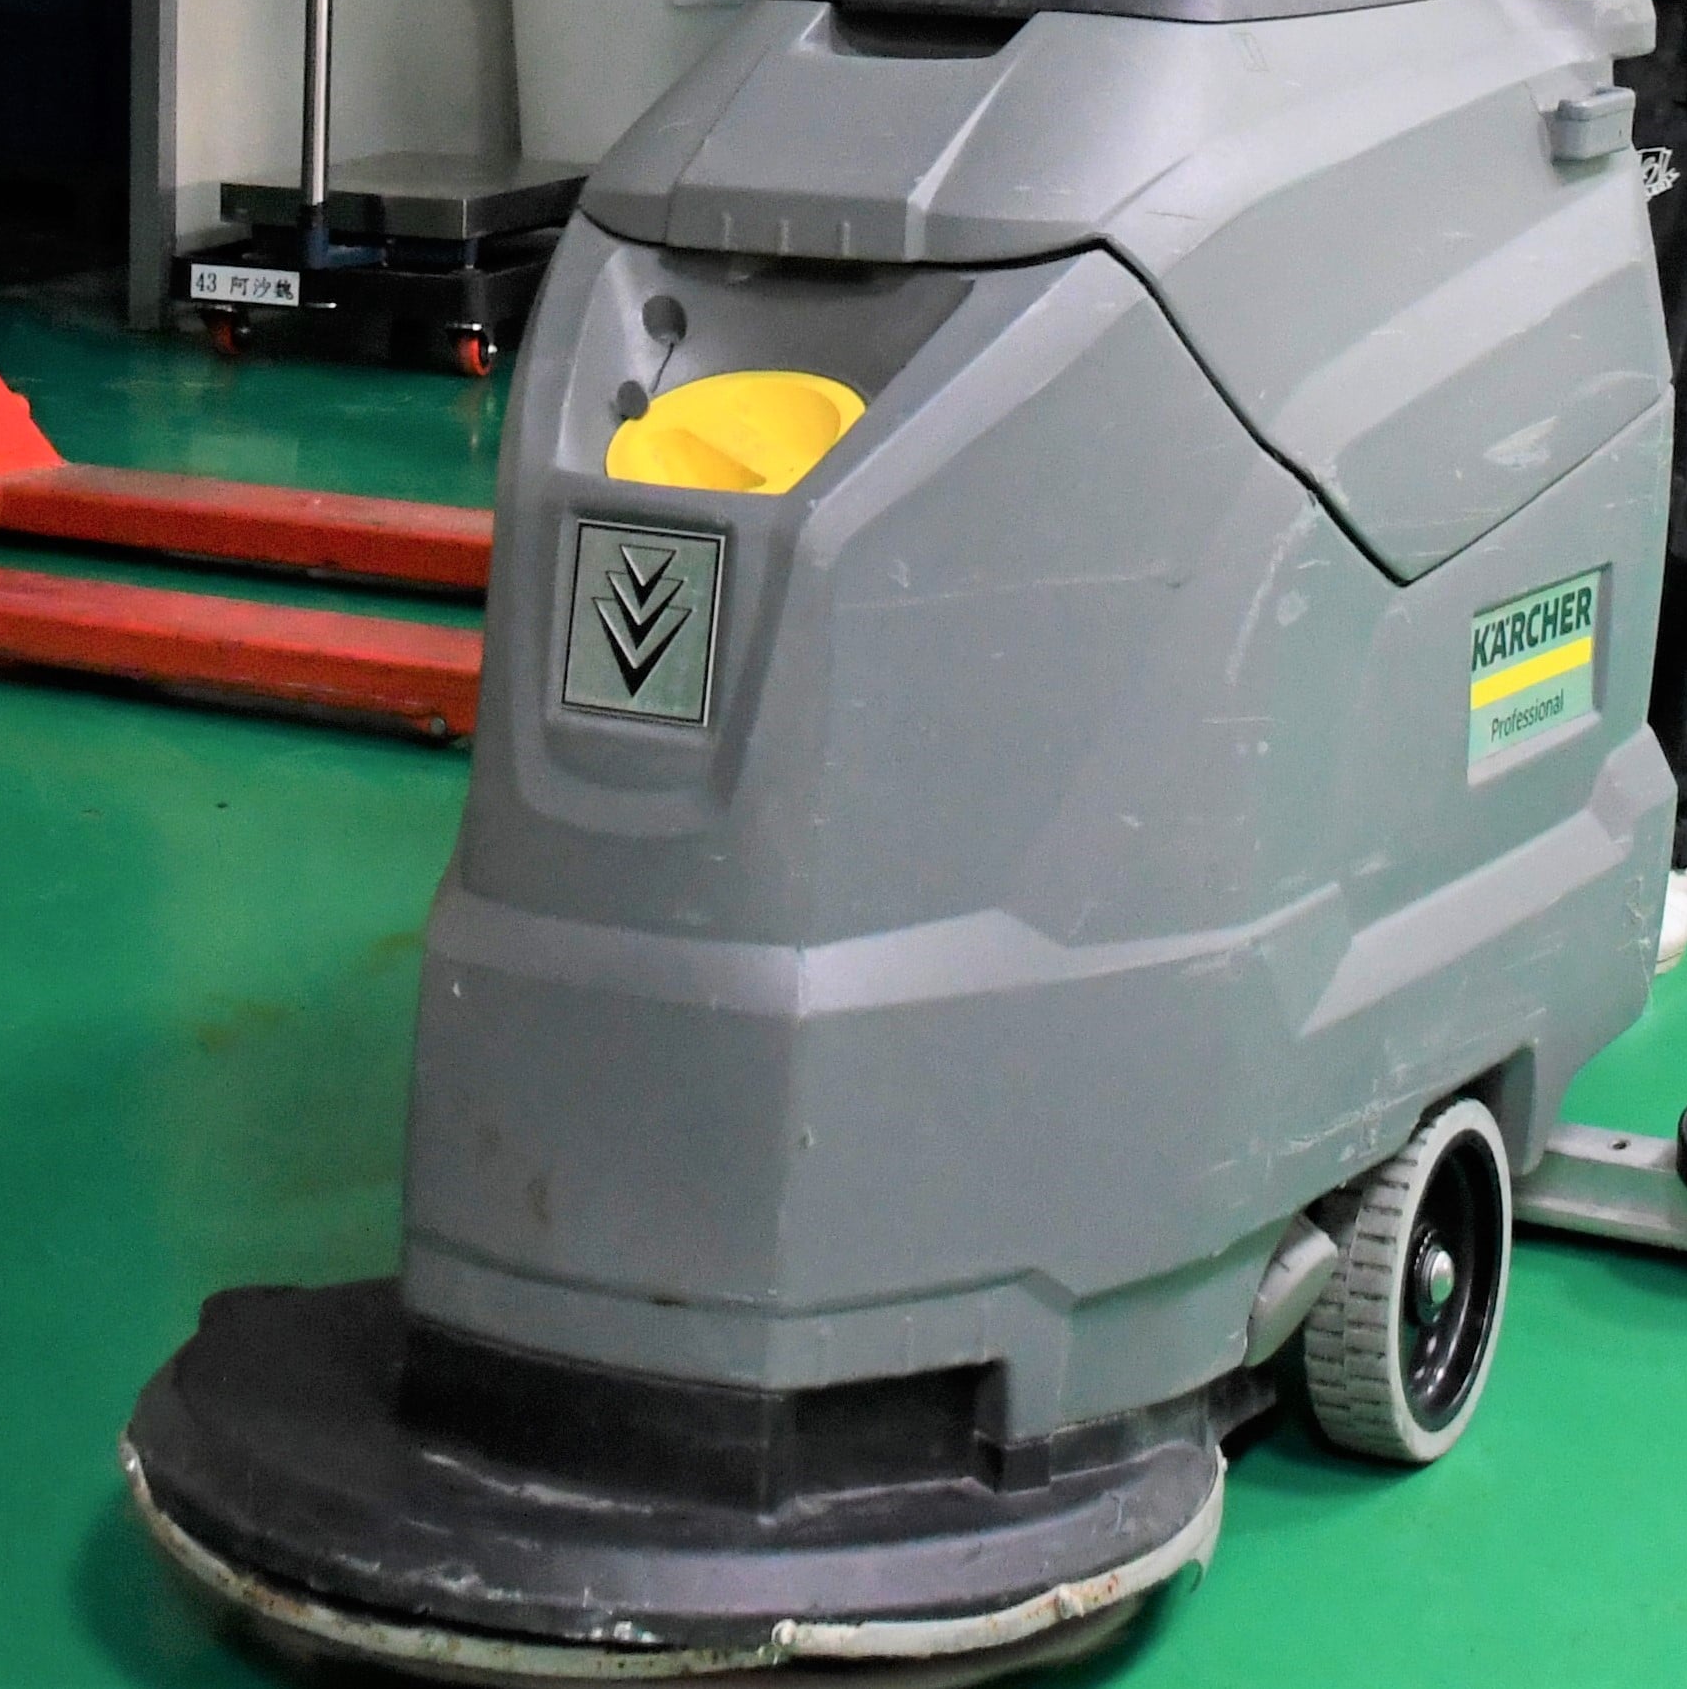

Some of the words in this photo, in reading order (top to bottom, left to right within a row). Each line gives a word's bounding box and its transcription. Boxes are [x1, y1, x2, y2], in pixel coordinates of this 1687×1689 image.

[196, 271, 217, 293] 43
[1471, 585, 1593, 672] KÄRCHER
[1491, 688, 1565, 743] Professional
